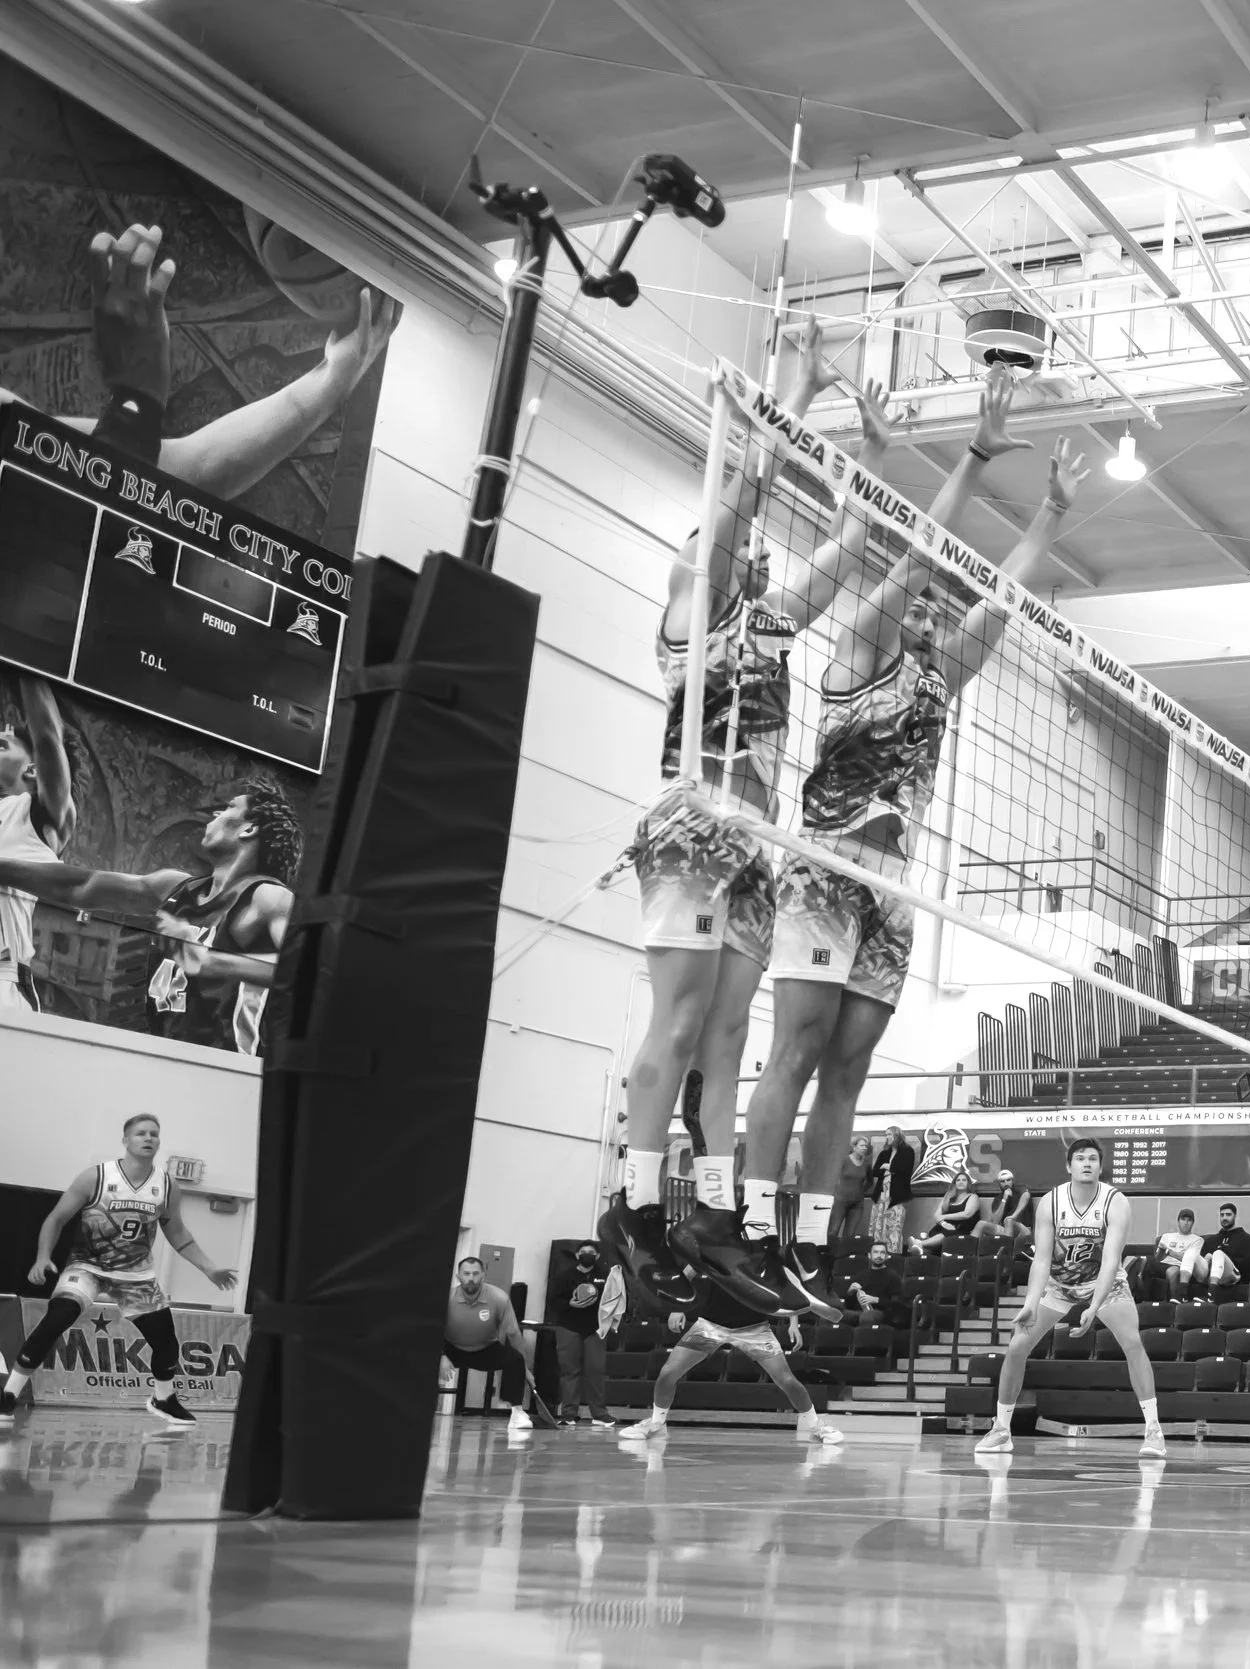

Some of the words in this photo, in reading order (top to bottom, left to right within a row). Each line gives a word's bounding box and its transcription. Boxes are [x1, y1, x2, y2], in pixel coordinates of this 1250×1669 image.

[14, 421, 112, 489] LONG
[119, 470, 222, 541] BEACH
[229, 524, 300, 575] CITY
[850, 470, 916, 531] NVAUSA
[940, 538, 999, 594] NVAUSA
[1019, 596, 1073, 648] NVAUSA
[1090, 648, 1135, 693] NVAUSA
[202, 612, 237, 635] PERIOD
[140, 651, 167, 672] T.O.L.
[252, 694, 278, 714] T.O.L.
[1026, 1114, 1076, 1123] WOMENS
[1082, 1112, 1162, 1122] BASKETBALL
[176, 1161, 195, 1178] EXIT
[109, 1201, 156, 1213] FOUNDERS
[120, 1218, 142, 1241] 9
[1065, 1243, 1094, 1263] 12
[43, 1329, 246, 1377] MIKSA
[86, 1375, 140, 1388] Official
[147, 1378, 184, 1390] Ge
[188, 1380, 214, 1390] Ball
